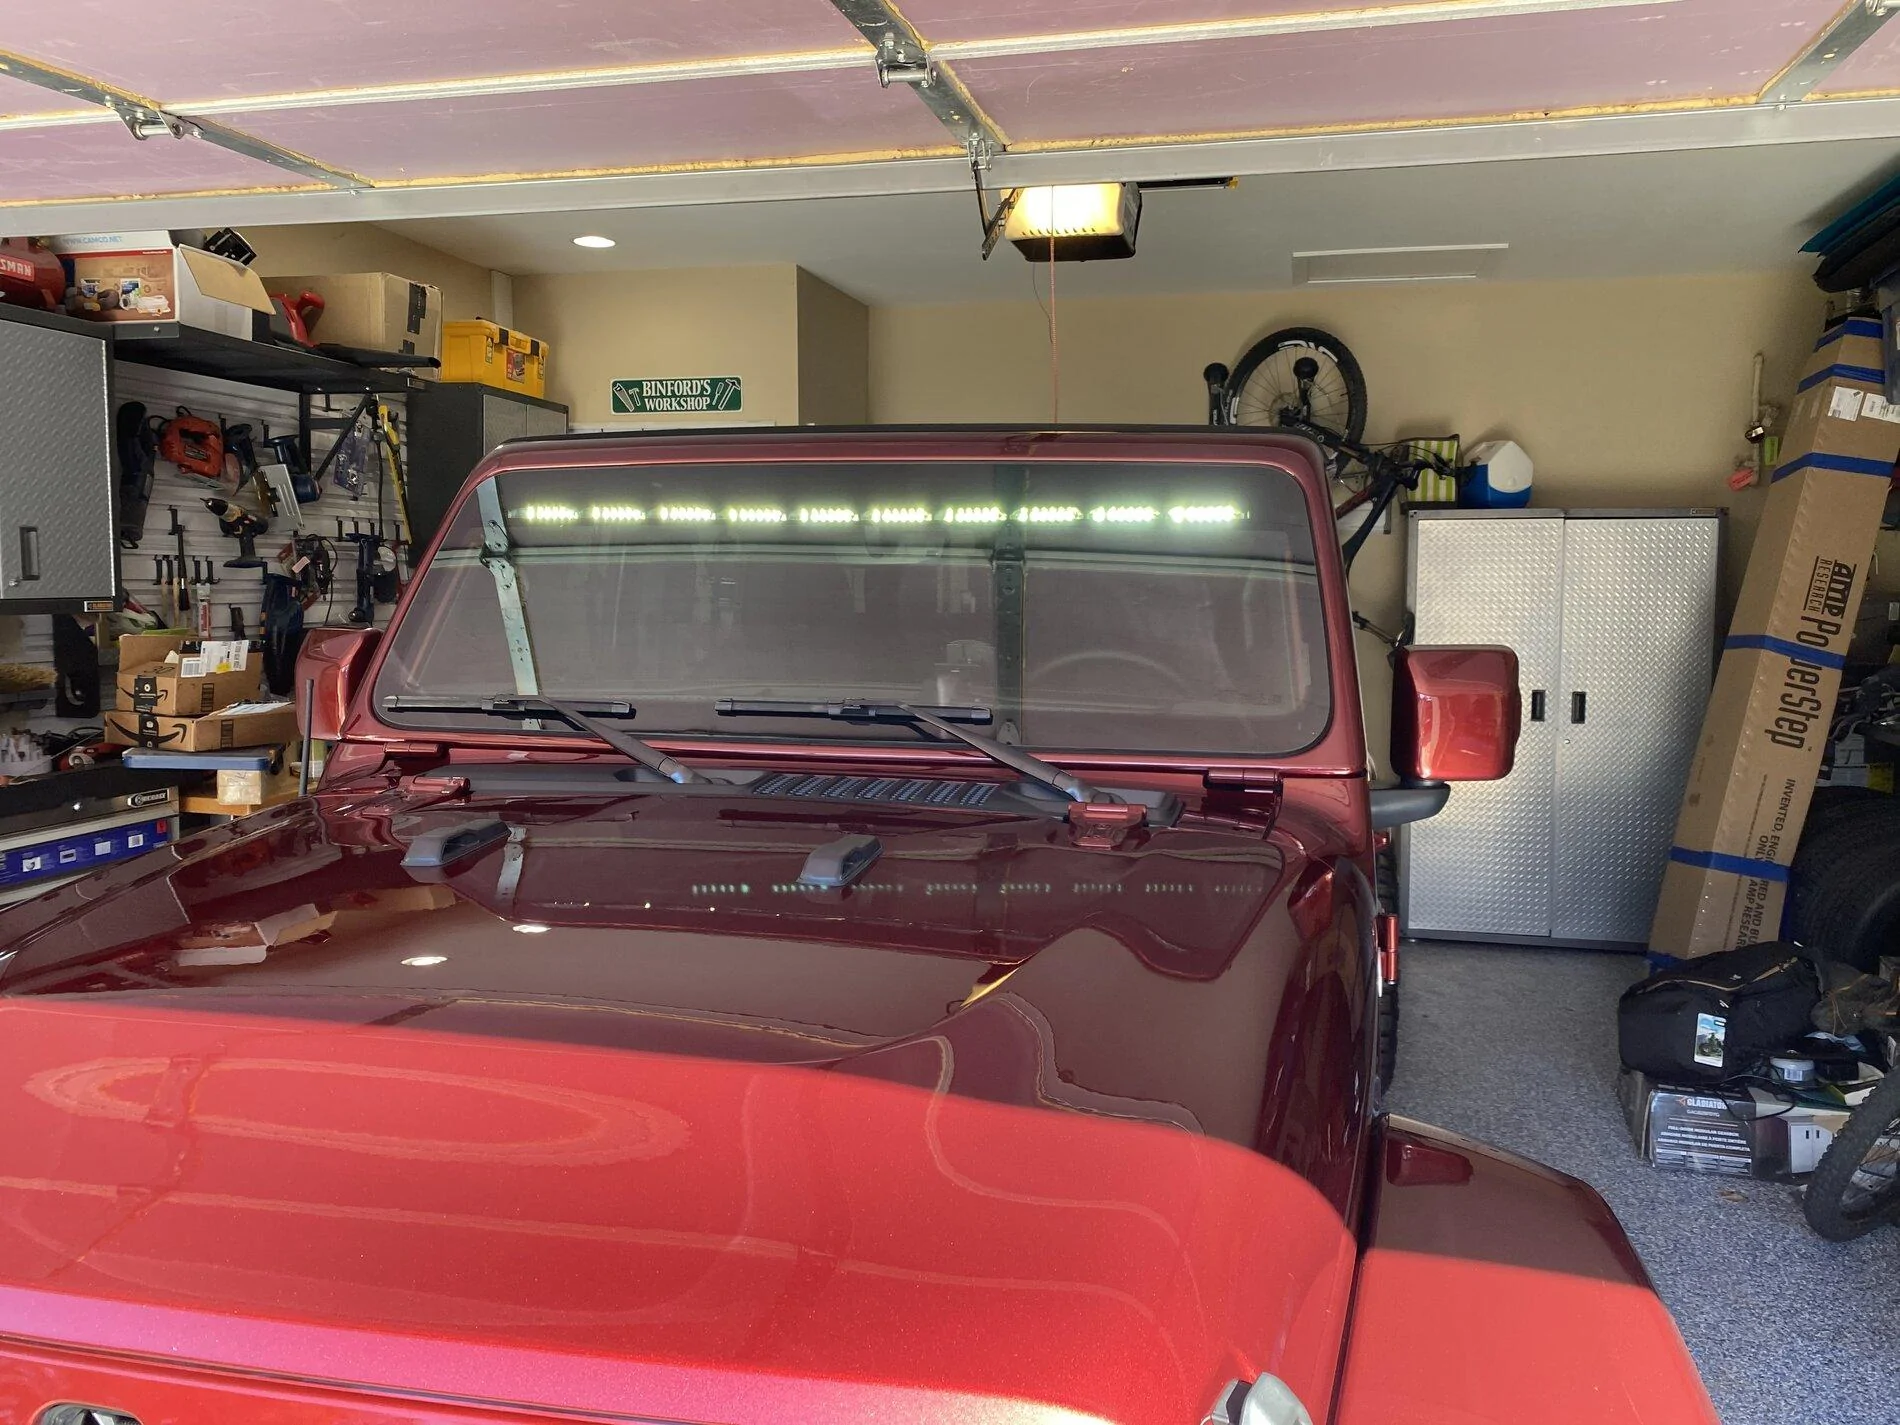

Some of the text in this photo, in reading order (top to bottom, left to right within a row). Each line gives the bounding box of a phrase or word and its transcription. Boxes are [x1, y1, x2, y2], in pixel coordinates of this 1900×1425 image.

[642, 379, 712, 397] BINFORD'S
[644, 397, 711, 411] WORKSHOP
[1807, 558, 1833, 613] RESEARCH
[1773, 778, 1796, 832] INVENTED,
[1745, 879, 1758, 904] AMP
[1754, 901, 1765, 927] AND
